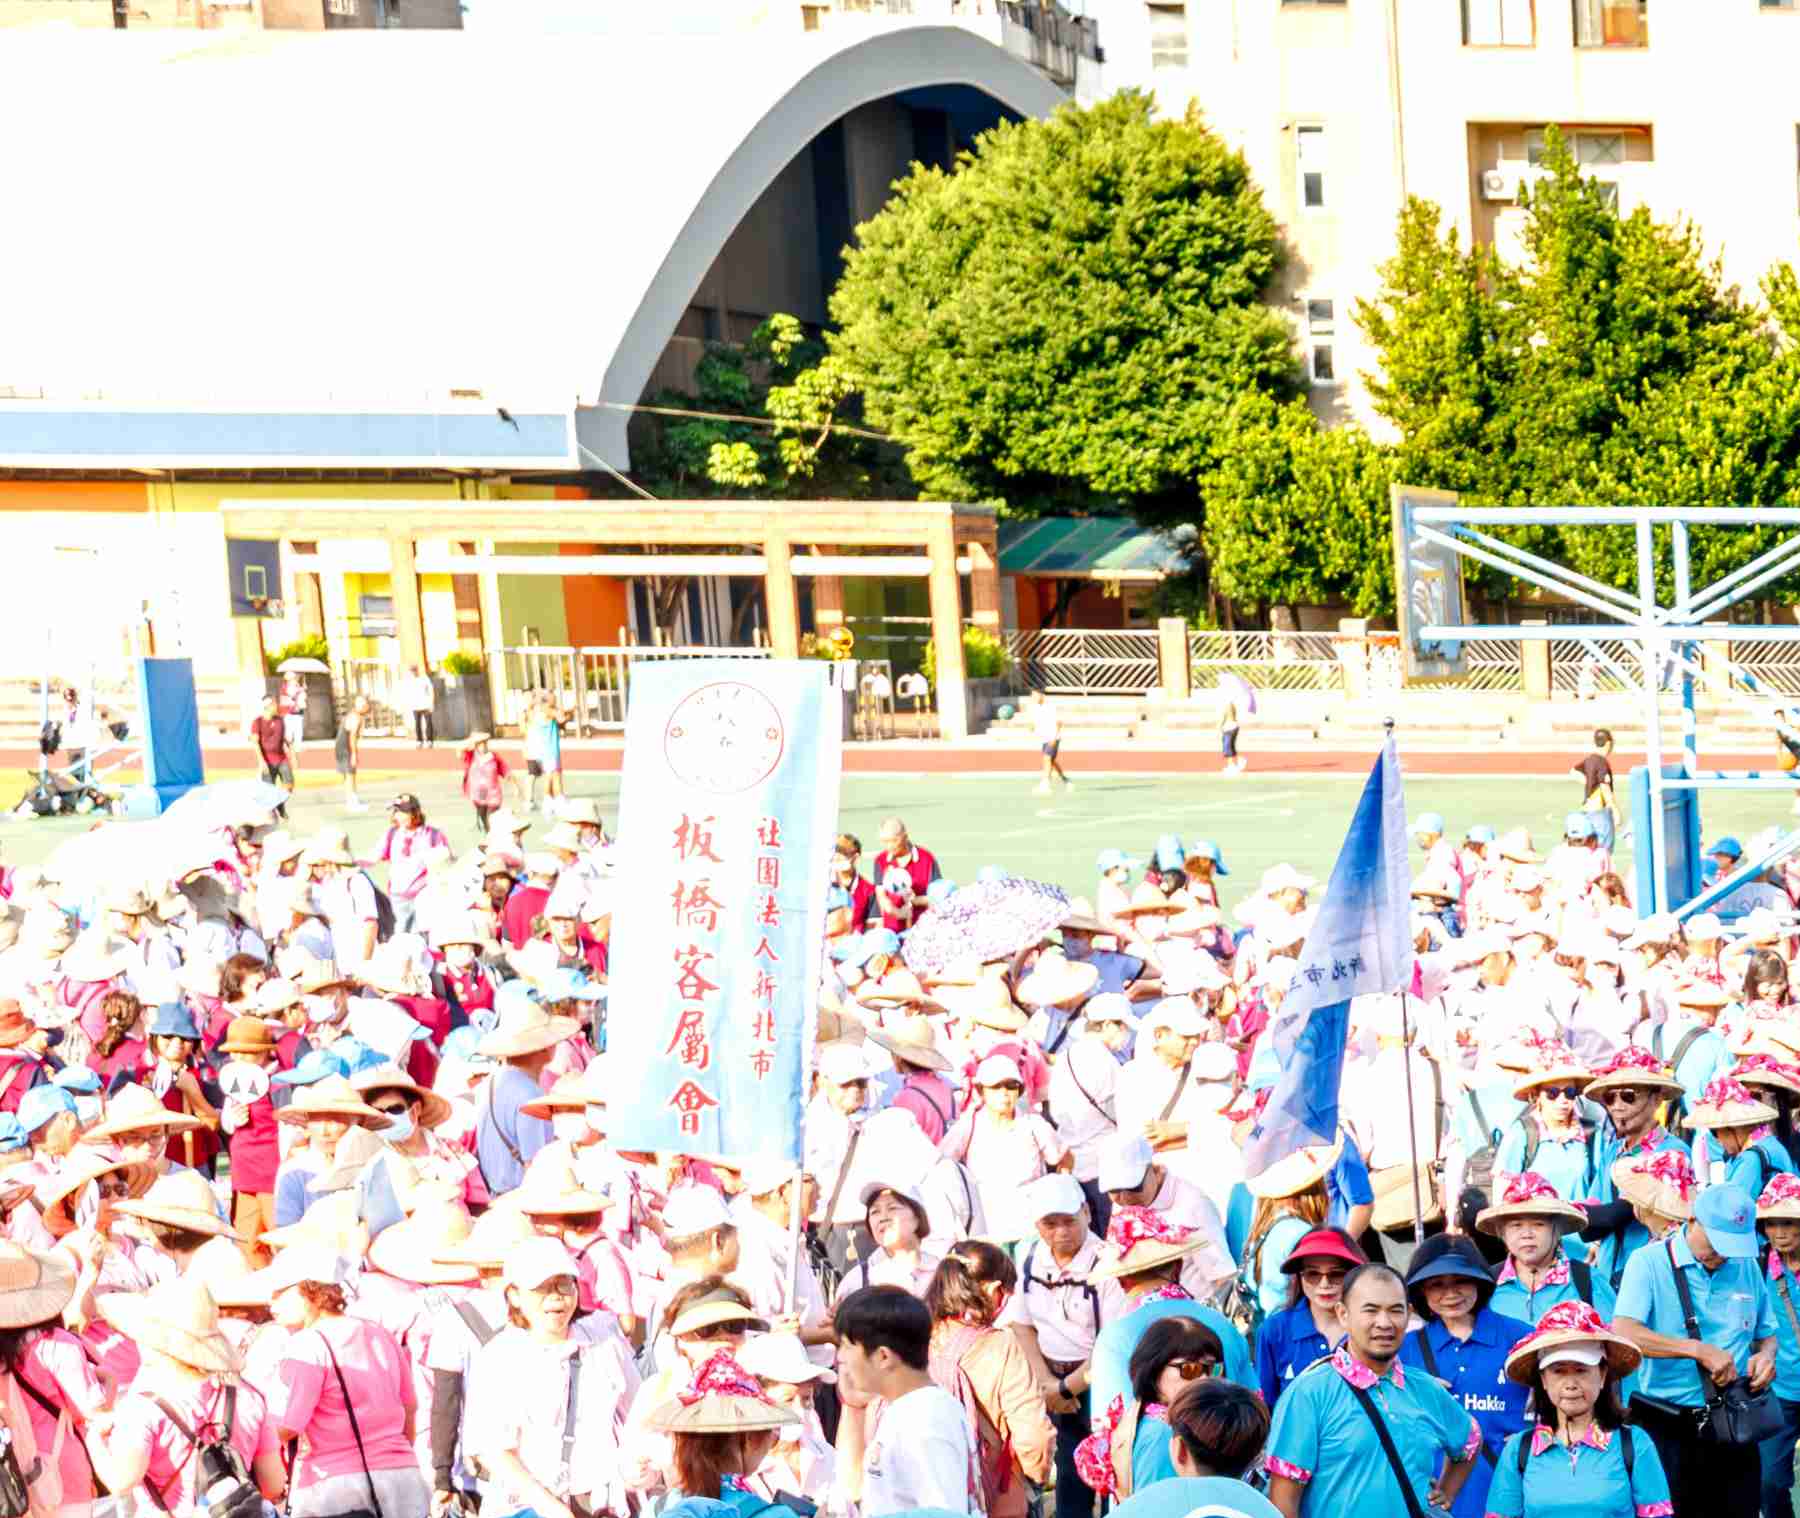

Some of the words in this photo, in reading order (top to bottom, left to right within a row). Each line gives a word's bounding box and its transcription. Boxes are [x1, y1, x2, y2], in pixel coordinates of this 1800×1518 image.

[666, 812, 725, 1135] 板橋客屬會
[749, 816, 783, 1080] 社團法人新北市
